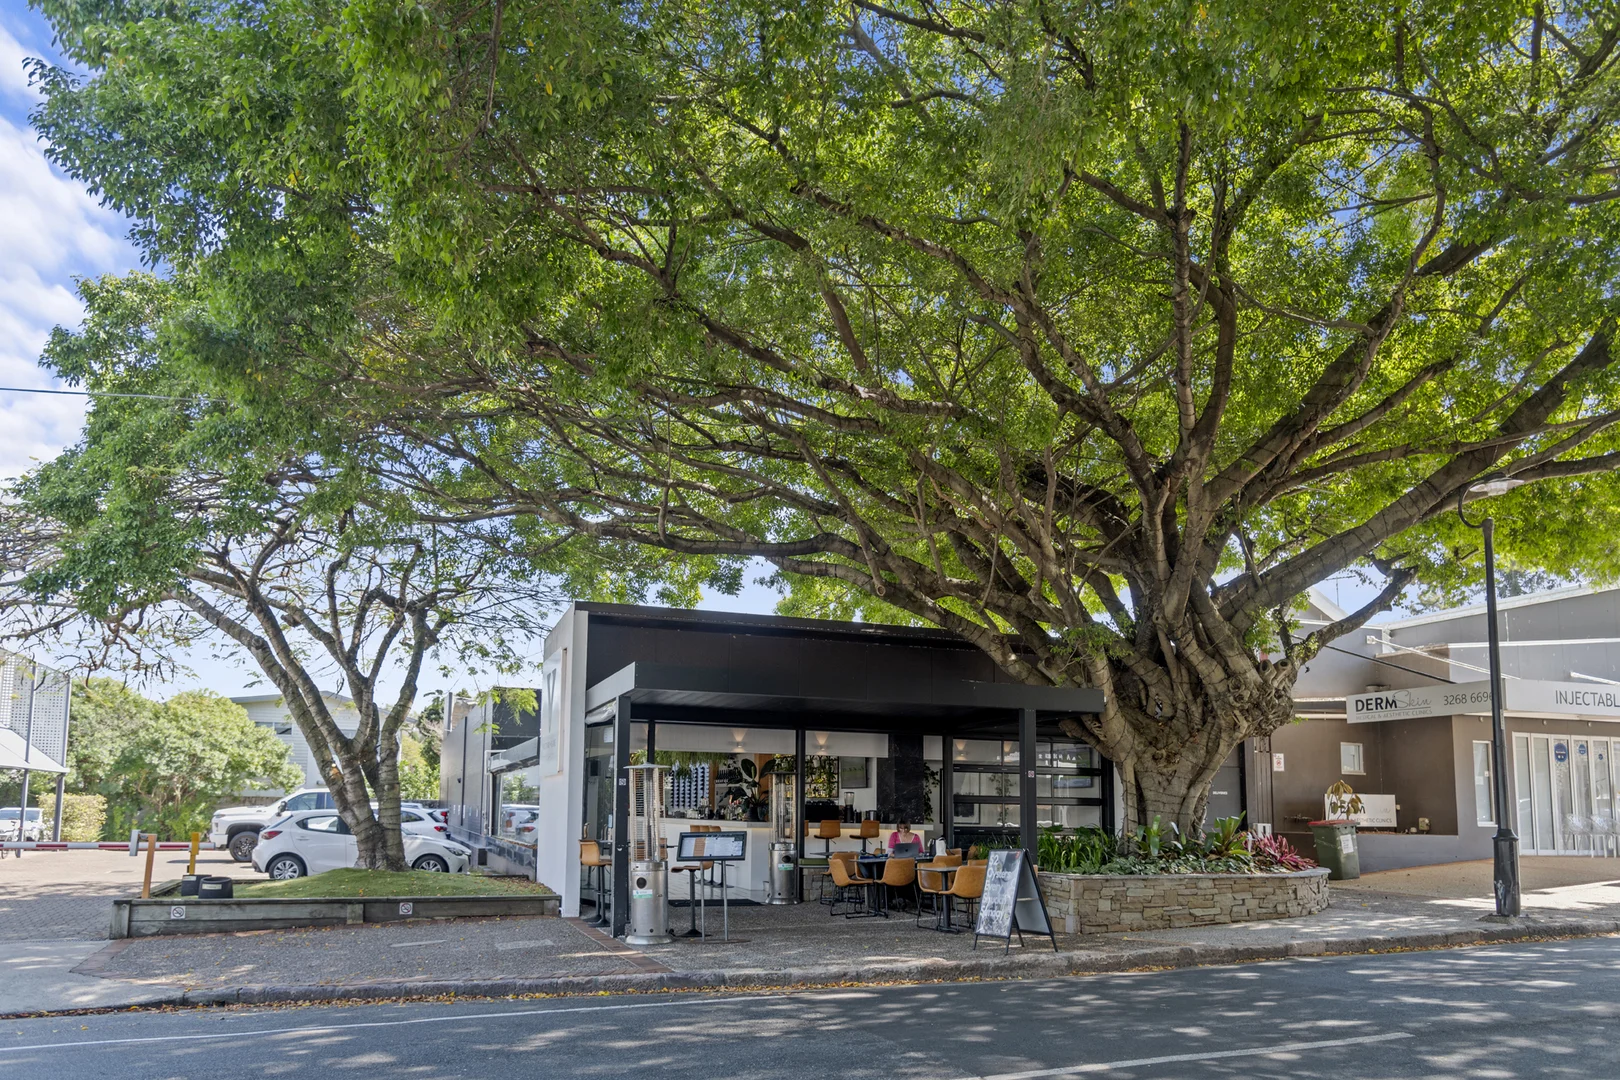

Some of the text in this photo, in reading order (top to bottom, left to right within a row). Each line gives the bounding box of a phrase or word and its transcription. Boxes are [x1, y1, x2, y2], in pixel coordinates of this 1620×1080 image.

[1355, 696, 1398, 712] DERM
[1443, 693, 1468, 706] 3268
[1412, 708, 1433, 717] CLINICS
